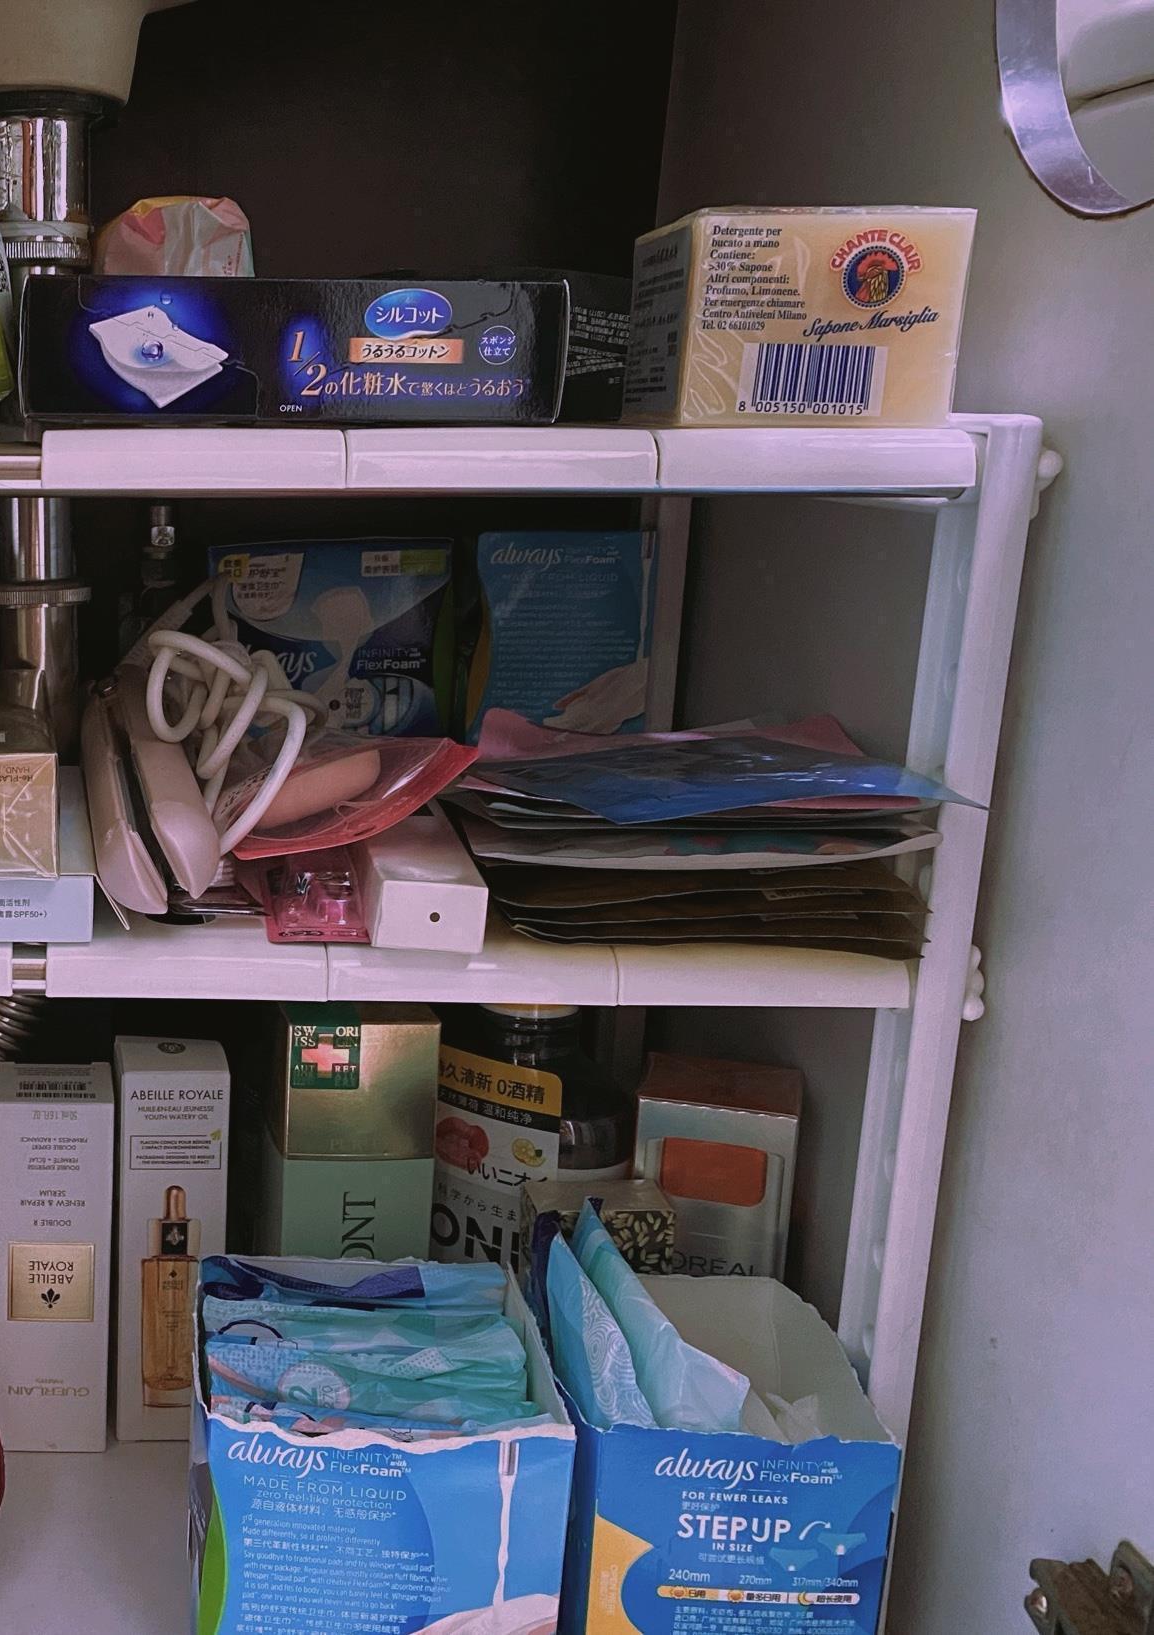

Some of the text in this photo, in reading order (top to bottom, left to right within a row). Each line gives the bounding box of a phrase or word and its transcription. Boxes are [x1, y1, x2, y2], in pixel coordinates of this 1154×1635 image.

[713, 225, 783, 239] Detergente per
[711, 238, 743, 248] bucato
[710, 249, 756, 260] Contiene:
[831, 229, 922, 272] CHANTE CLAIR
[708, 261, 774, 274] >30% Sapone
[707, 273, 790, 286] Altri componenti:
[705, 285, 801, 297] Profumo, Limonene.
[704, 297, 806, 309] Per emergenze chiamare
[374, 305, 446, 324] シルコット
[702, 308, 808, 321] Centro Antiveleni Milano
[702, 320, 766, 331] Tel. 02 66101029
[803, 305, 940, 343] Sapone Marsiglia
[480, 335, 517, 346] スポンジ
[362, 344, 451, 359] うるうるコットン
[483, 346, 511, 357] 仕立て
[279, 404, 303, 413] OPEN
[738, 399, 864, 416] 8 005150 001015
[490, 541, 564, 571] always
[294, 1025, 317, 1037] SW
[335, 1025, 359, 1037] ORI
[439, 1061, 493, 1094] 久清新
[130, 1089, 224, 1101] ABEILLE ROYALE
[39, 1189, 66, 1198] SERUM
[20, 1199, 86, 1207] RENEW REPAIR
[40, 1219, 72, 1227] DOUBLE
[29, 1260, 74, 1272] ROYALE
[28, 1273, 74, 1285] ABEILLE
[7, 1385, 90, 1398] GUERLAIN
[288, 1385, 318, 1406] 2
[227, 1433, 329, 1479] always
[654, 1447, 759, 1490] always
[243, 1475, 408, 1502] MADE FROM LIQUID
[256, 1488, 283, 1500] zero
[332, 1497, 393, 1511] protection
[681, 1490, 789, 1505] FOR FEWER LEAKS
[242, 1526, 261, 1536] Made
[253, 1518, 291, 1529] generation
[326, 1524, 356, 1534] material
[677, 1512, 792, 1544] STEP UP
[712, 1541, 754, 1553] IN SIZE
[668, 1568, 711, 1583] 240mm
[738, 1574, 773, 1586] 270mm
[687, 1589, 707, 1599] 日用
